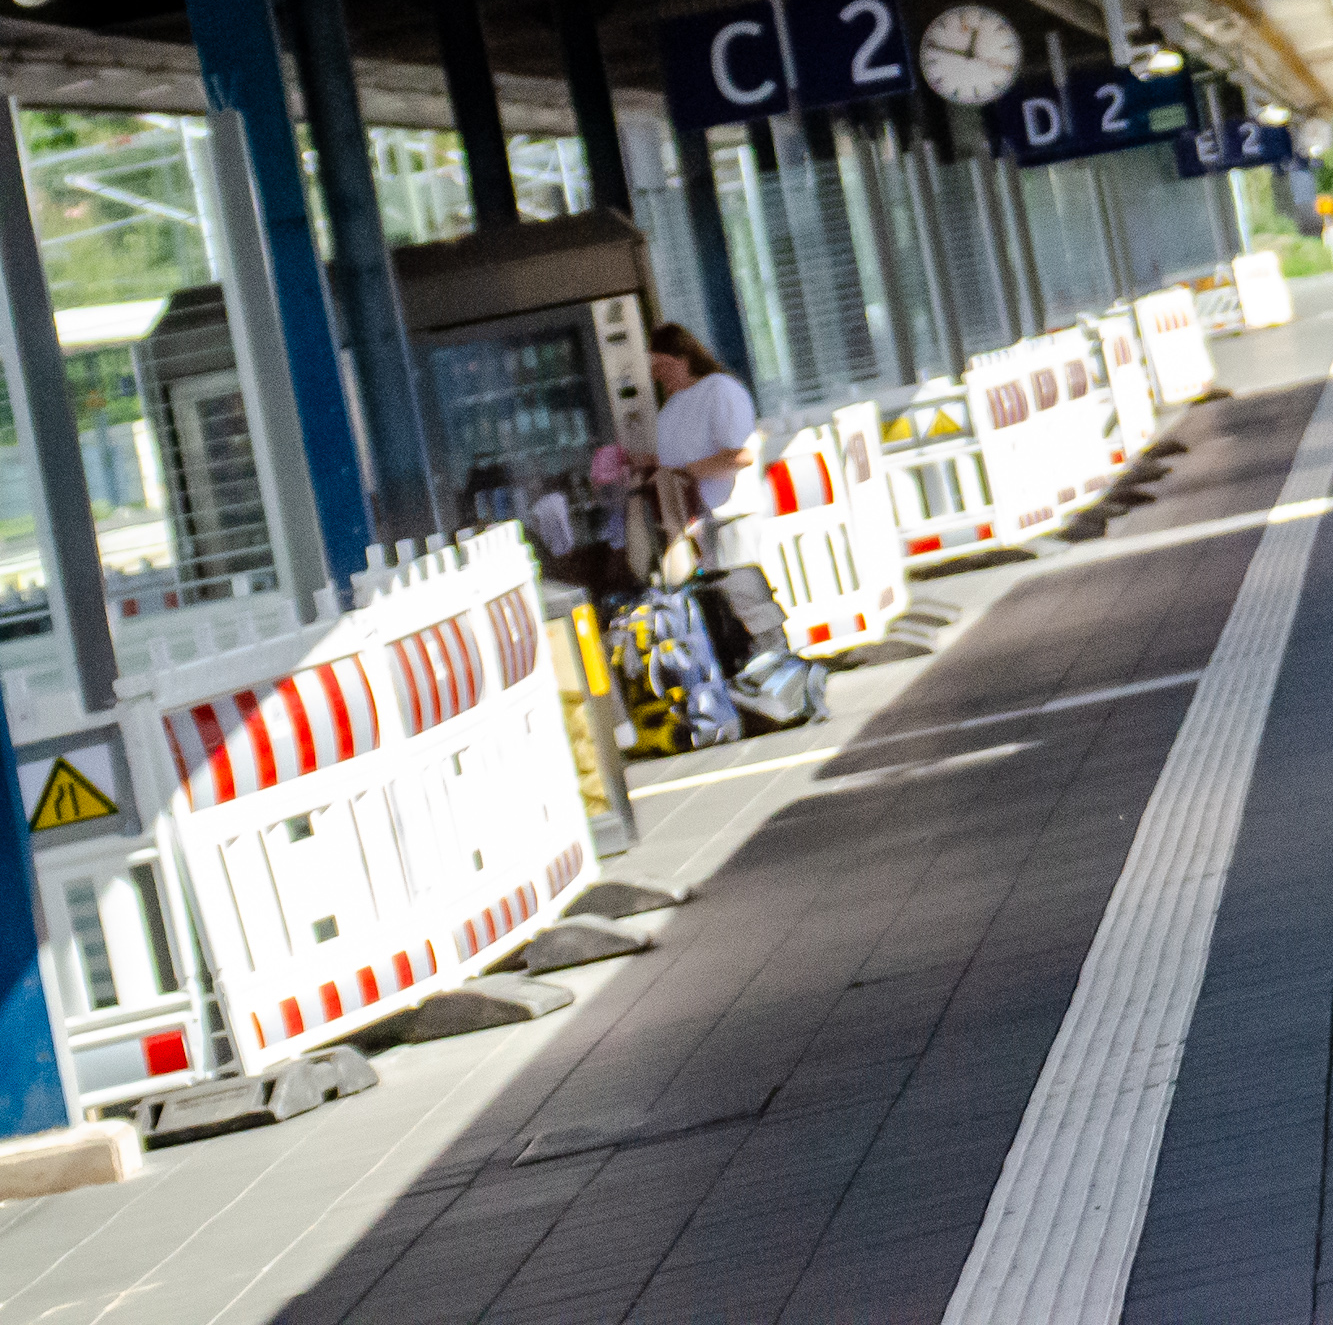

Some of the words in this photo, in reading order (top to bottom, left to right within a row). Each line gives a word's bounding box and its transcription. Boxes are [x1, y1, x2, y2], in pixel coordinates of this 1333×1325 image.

[709, 20, 777, 106] C
[1021, 96, 1064, 147] D
[1094, 82, 1130, 134] 2
[1238, 121, 1264, 157] 2
